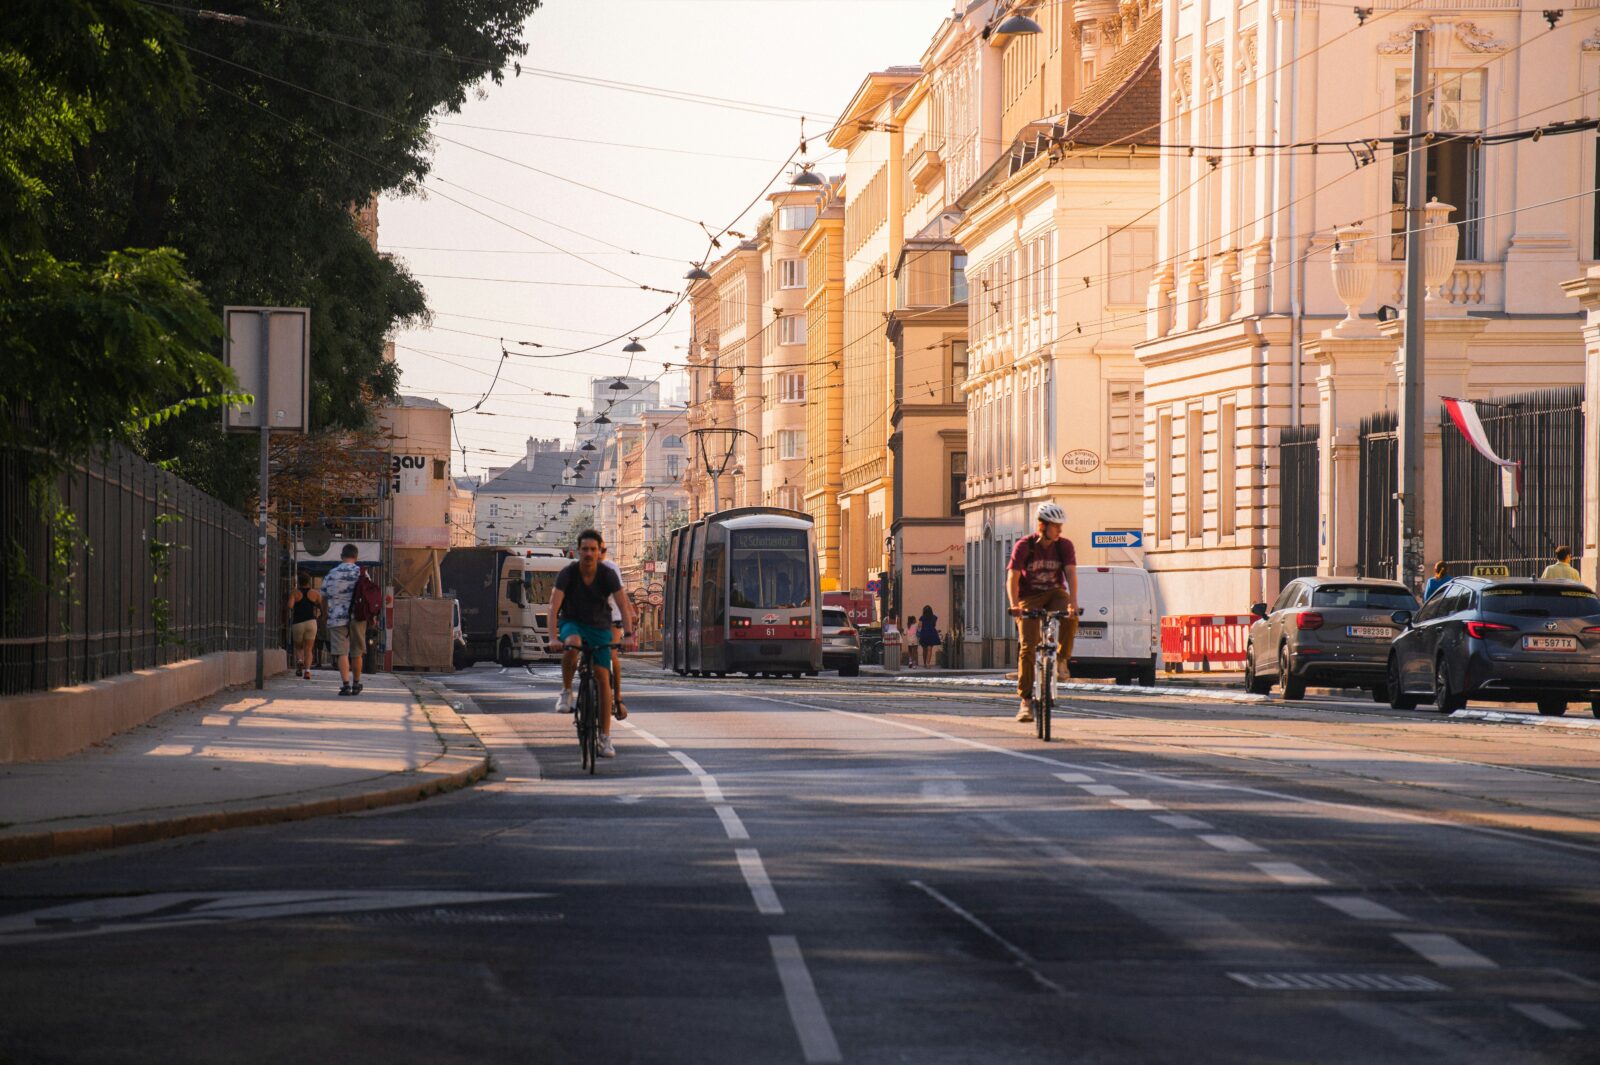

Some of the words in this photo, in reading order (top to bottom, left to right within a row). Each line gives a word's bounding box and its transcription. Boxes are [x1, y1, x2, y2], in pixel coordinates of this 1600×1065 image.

[1478, 567, 1504, 576] TAXI
[766, 628, 775, 636] 61
[1533, 639, 1539, 647] W
[1545, 639, 1559, 647] 597
[1562, 640, 1572, 648] TX
